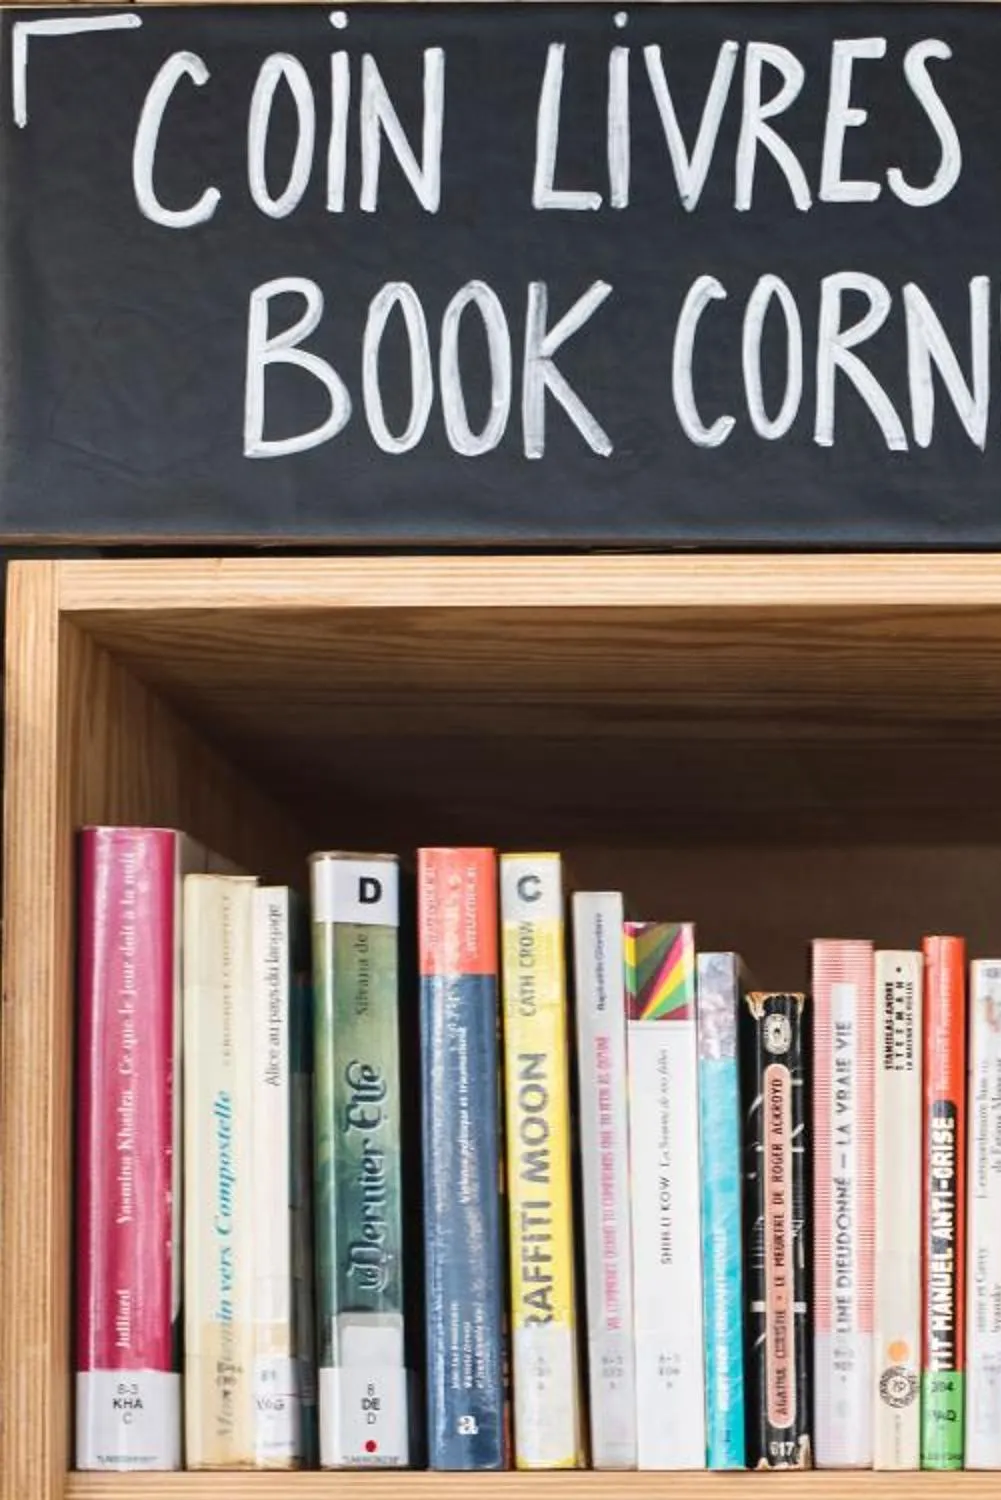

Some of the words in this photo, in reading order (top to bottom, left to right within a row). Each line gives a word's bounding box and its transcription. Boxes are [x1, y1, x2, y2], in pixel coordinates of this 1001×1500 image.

[244, 276, 613, 459] BOOK
[358, 876, 384, 905] D
[516, 874, 543, 903] C
[264, 903, 286, 964] langage
[352, 933, 368, 954] de
[518, 921, 536, 969] CROW
[264, 966, 281, 987] du
[519, 974, 537, 1018] CATH
[268, 988, 286, 1024] pays
[120, 1020, 139, 1050] que
[268, 1026, 281, 1047] au
[834, 1020, 851, 1049] VIE
[264, 1050, 281, 1088] Alice
[835, 1060, 851, 1114] VRAIE
[340, 1059, 388, 1134] Elfe
[517, 1052, 550, 1184] MOON
[771, 1078, 784, 1135] ACKROYD
[117, 1089, 134, 1152] Khadra
[835, 1123, 851, 1146] LA
[212, 1089, 238, 1237] Compostelle
[770, 1142, 784, 1183] ROGER
[930, 1116, 955, 1241] ANTI-CRISE
[115, 1161, 134, 1224] Yasmina
[344, 1137, 392, 1276] Dernier
[659, 1176, 671, 1211] KOW
[771, 1190, 784, 1206] DE
[772, 1213, 786, 1267] MEURTRE
[832, 1176, 852, 1289] DIEUDONNÉ
[216, 1246, 233, 1293] vers
[520, 1200, 554, 1328] RAFFITI
[929, 1247, 954, 1332] MANUEL
[115, 1288, 132, 1349] Julliard
[835, 1295, 851, 1333] LINE
[931, 1338, 954, 1372] TIT
[112, 1397, 143, 1411] KHA
[360, 1397, 382, 1412] DE
